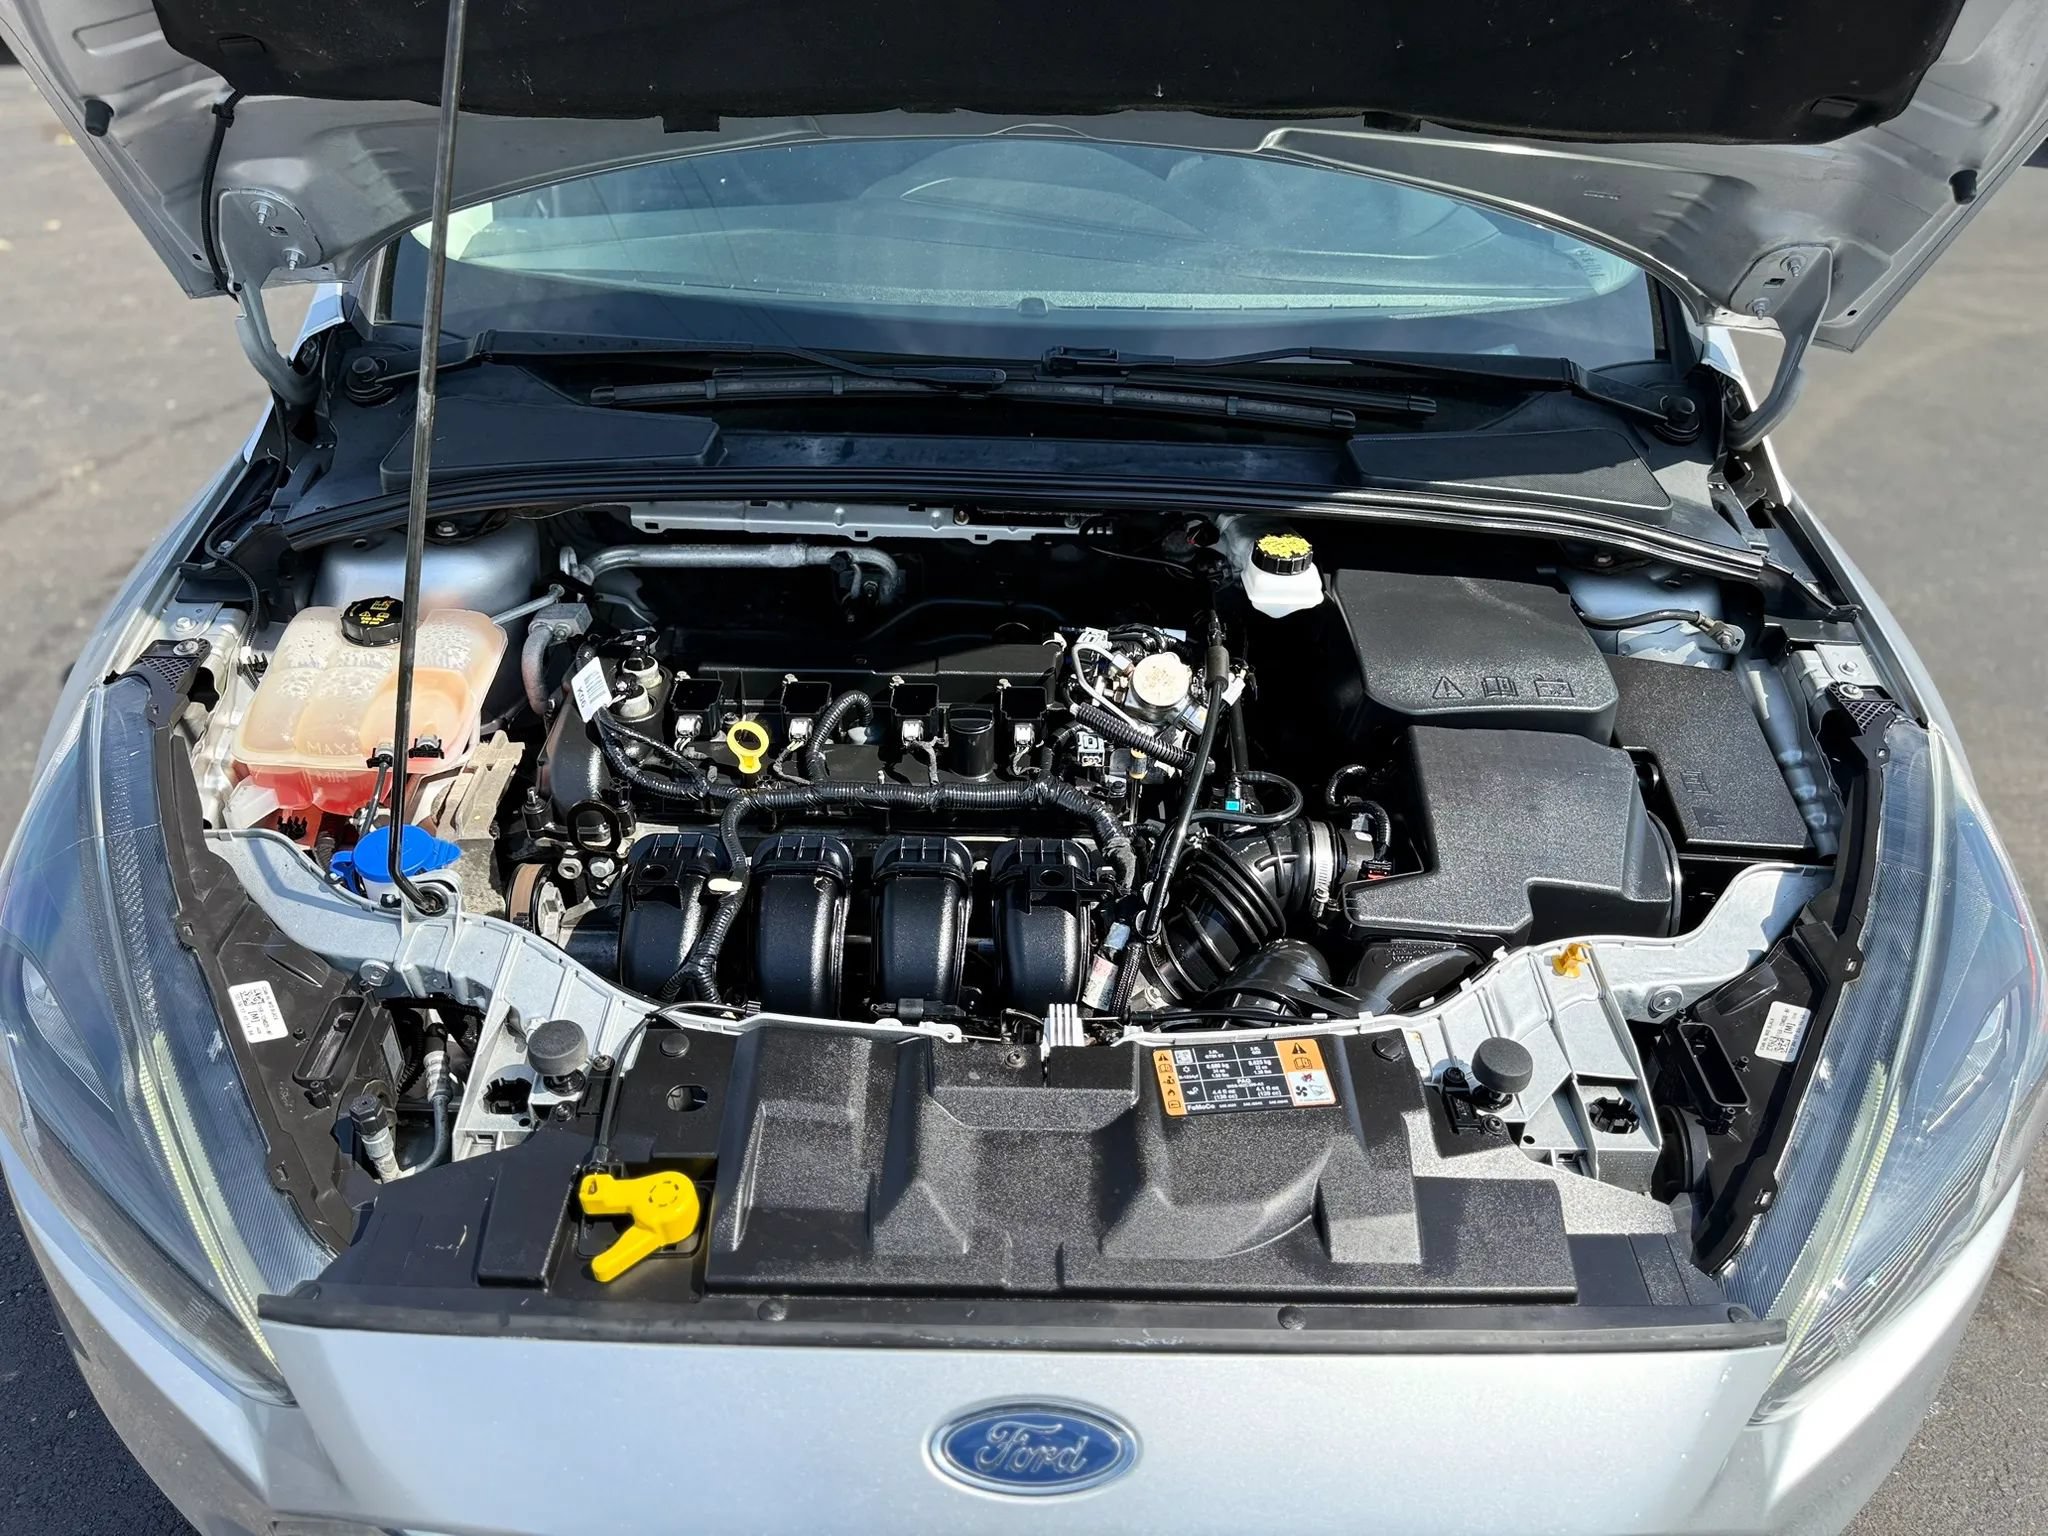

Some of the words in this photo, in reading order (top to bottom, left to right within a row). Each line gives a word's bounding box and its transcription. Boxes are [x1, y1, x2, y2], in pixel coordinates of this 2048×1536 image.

[307, 740, 348, 755] MAX
[317, 770, 348, 783] MIN
[975, 1421, 1089, 1473] Ford
